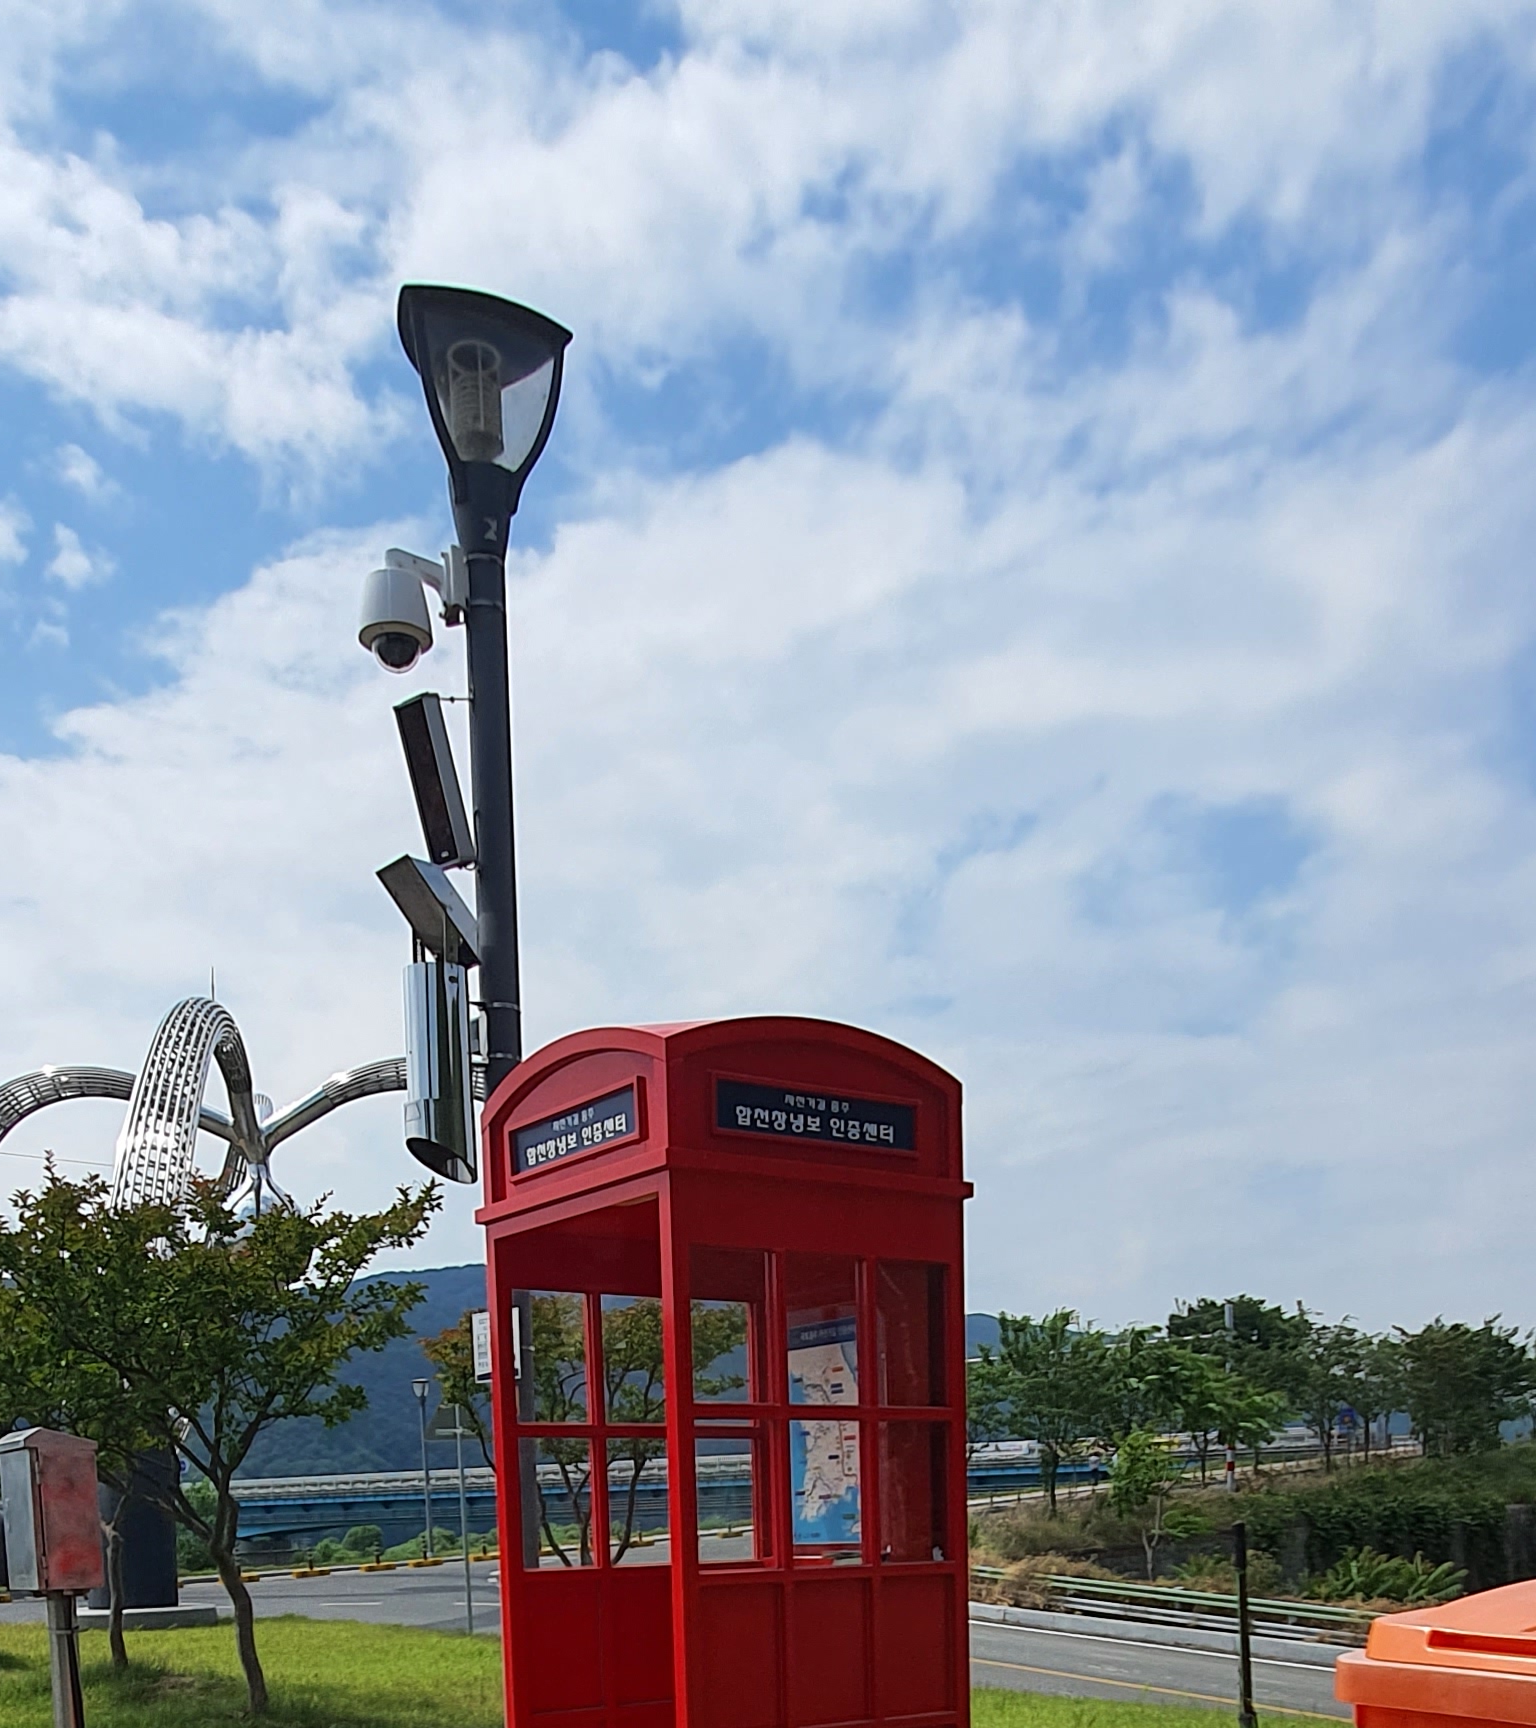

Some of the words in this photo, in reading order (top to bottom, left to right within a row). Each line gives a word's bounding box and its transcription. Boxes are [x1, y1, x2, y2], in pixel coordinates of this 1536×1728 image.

[581, 1113, 627, 1146] 인증센터
[735, 1105, 822, 1133] 합천창녕보
[830, 1117, 895, 1144] 인증센터
